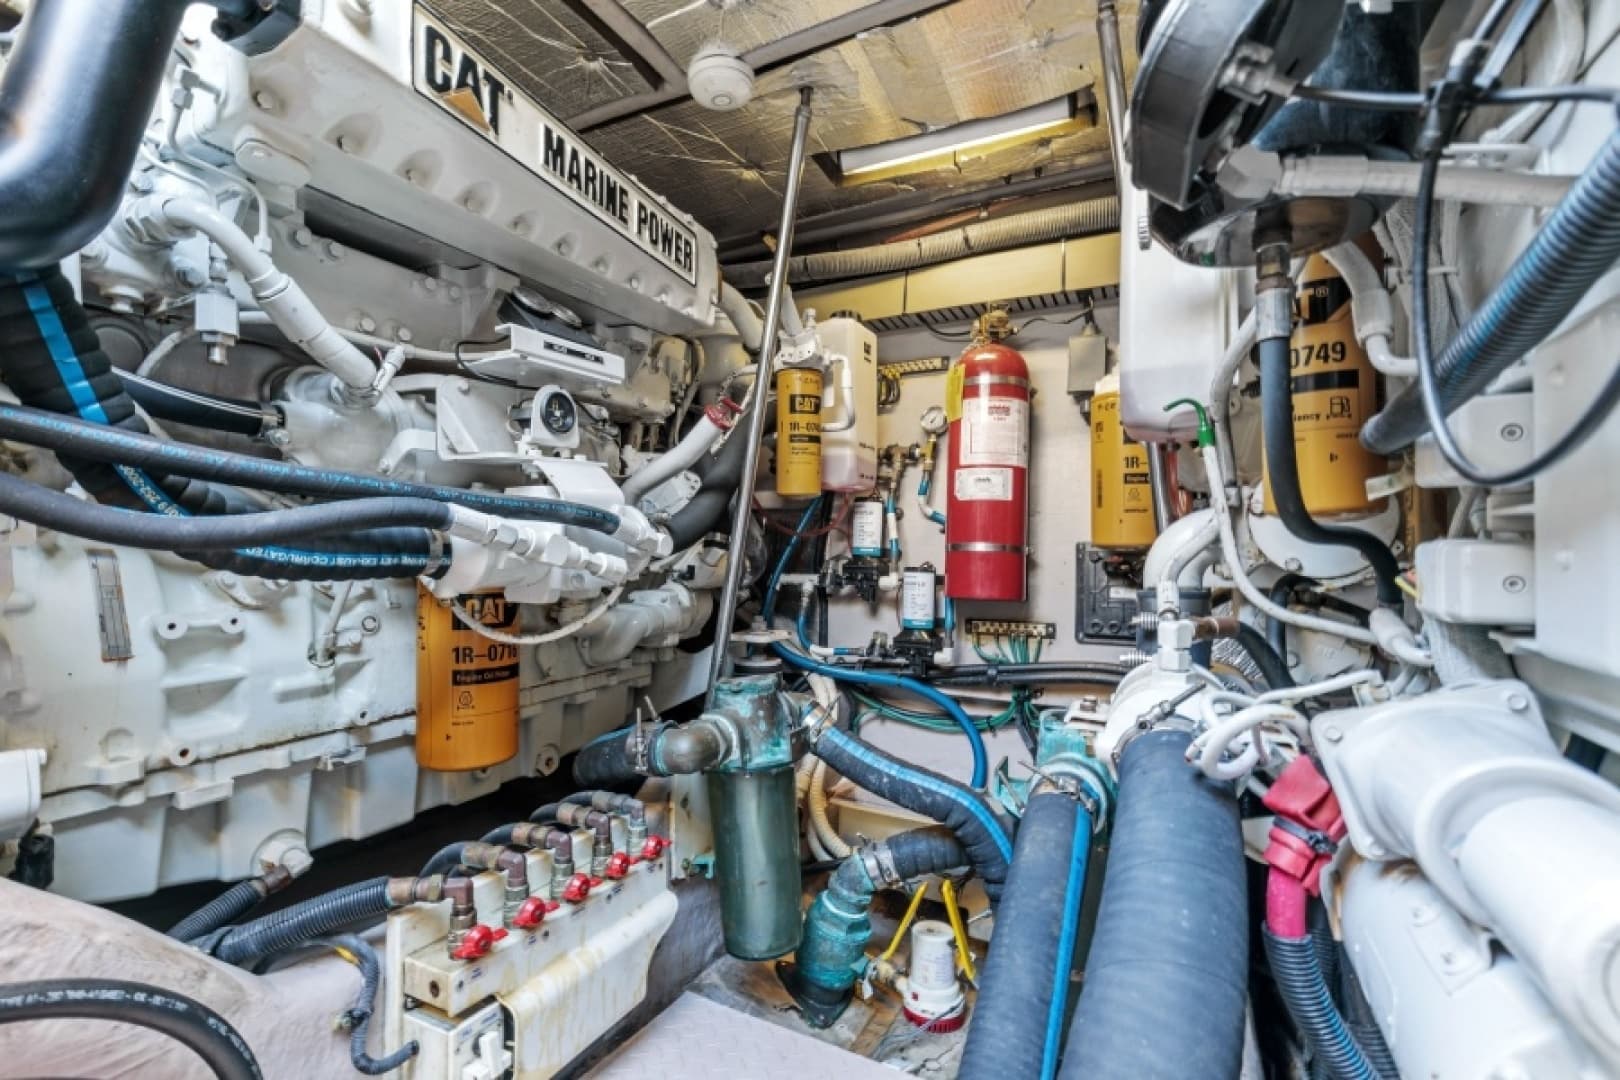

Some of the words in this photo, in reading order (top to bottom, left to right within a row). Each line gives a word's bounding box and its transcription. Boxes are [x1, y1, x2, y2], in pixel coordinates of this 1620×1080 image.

[425, 24, 505, 137] CAT
[543, 122, 629, 226] MARINE
[637, 201, 693, 273] POWER
